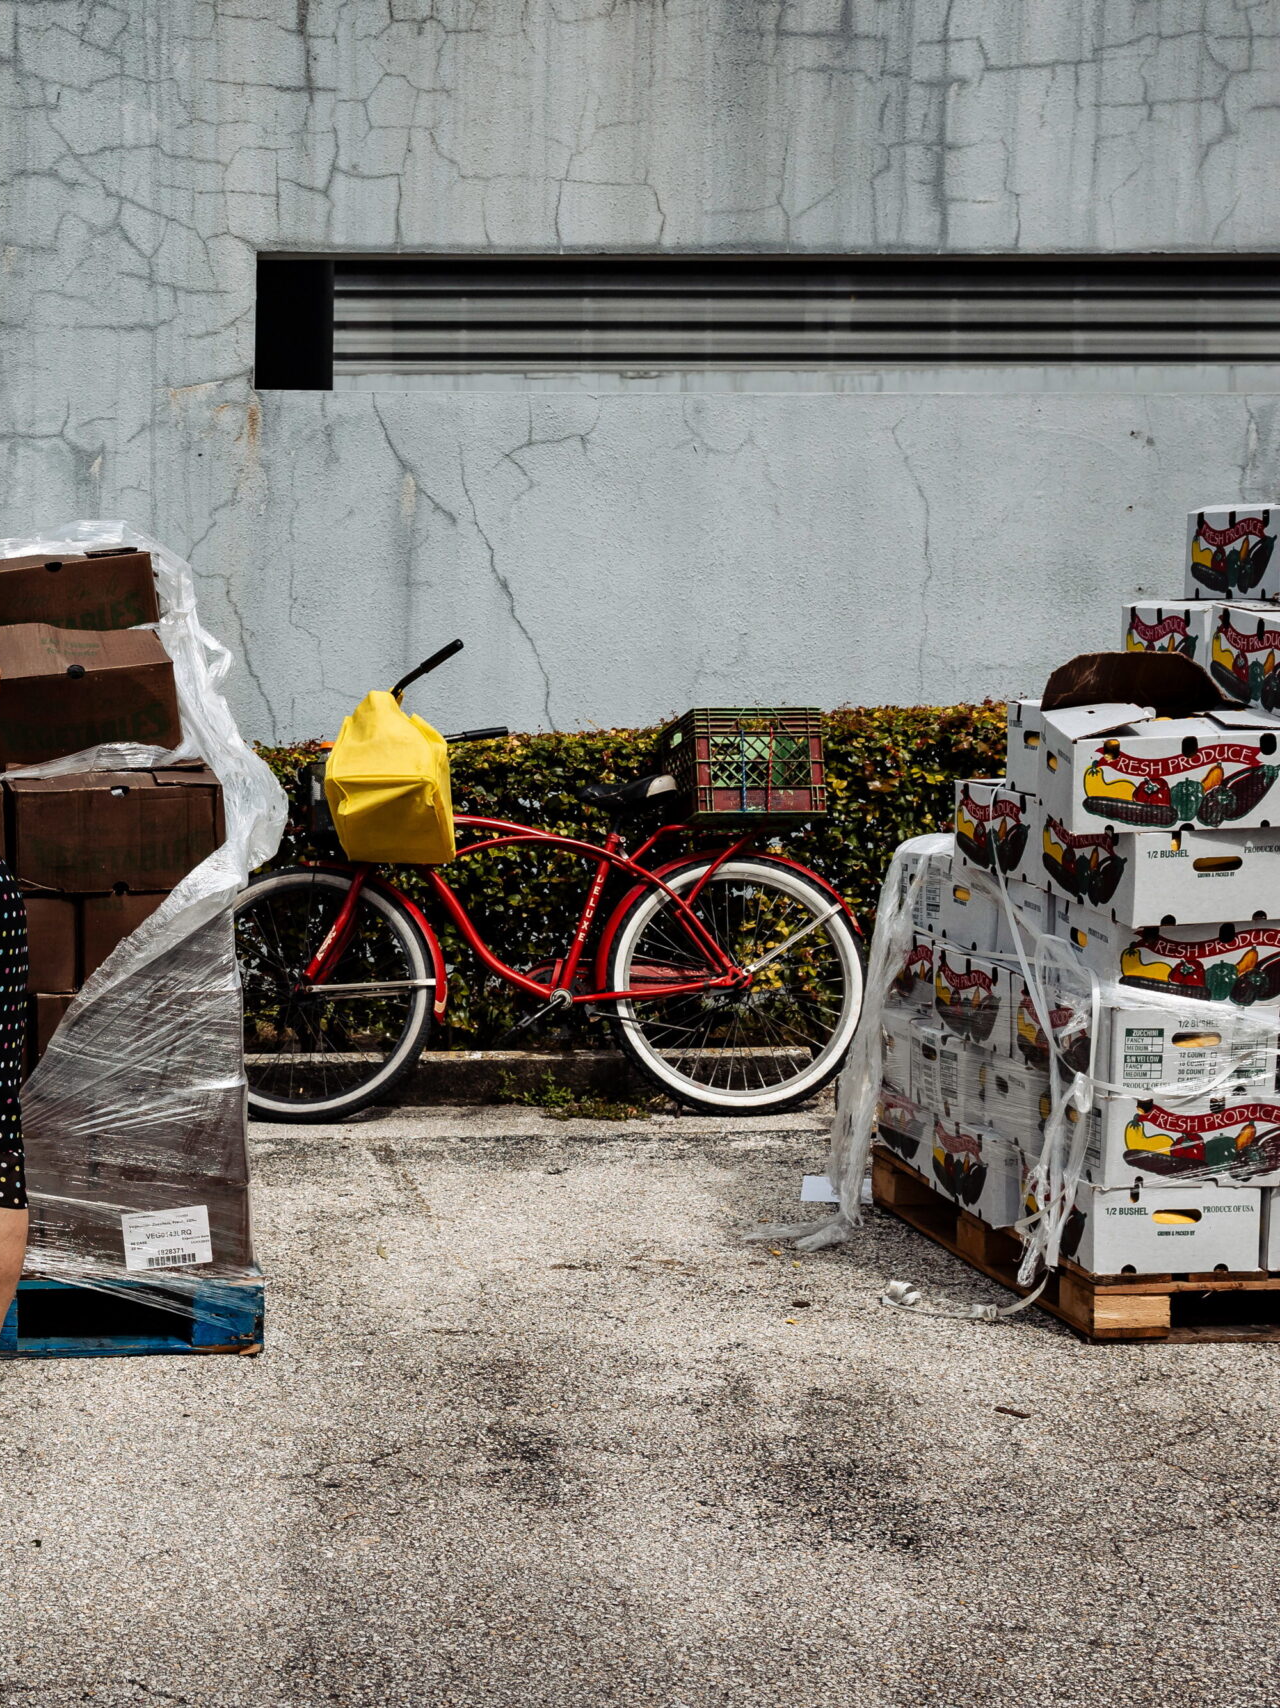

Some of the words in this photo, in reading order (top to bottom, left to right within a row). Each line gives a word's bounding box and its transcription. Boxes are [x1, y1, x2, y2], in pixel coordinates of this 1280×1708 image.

[1226, 520, 1262, 543] PRODUCE
[1155, 617, 1185, 638] PRODUCE
[1227, 629, 1247, 650] RESH
[1116, 756, 1162, 775] RESH
[1170, 746, 1253, 772] PRODUCE
[1147, 851, 1158, 859] 1/2
[1160, 849, 1189, 858] BUSHEL
[1244, 845, 1273, 853] PRODUCE
[1155, 940, 1198, 957] RESH
[1132, 1029, 1159, 1037] ZUCCHINI
[1179, 1020, 1189, 1028] 1/2
[1147, 1108, 1198, 1132] FRESH
[1204, 1105, 1280, 1129] PRODUCE
[1105, 1207, 1117, 1215] 1/2
[1119, 1207, 1149, 1216] BUSHEL
[1203, 1205, 1232, 1213] PRODUCE
